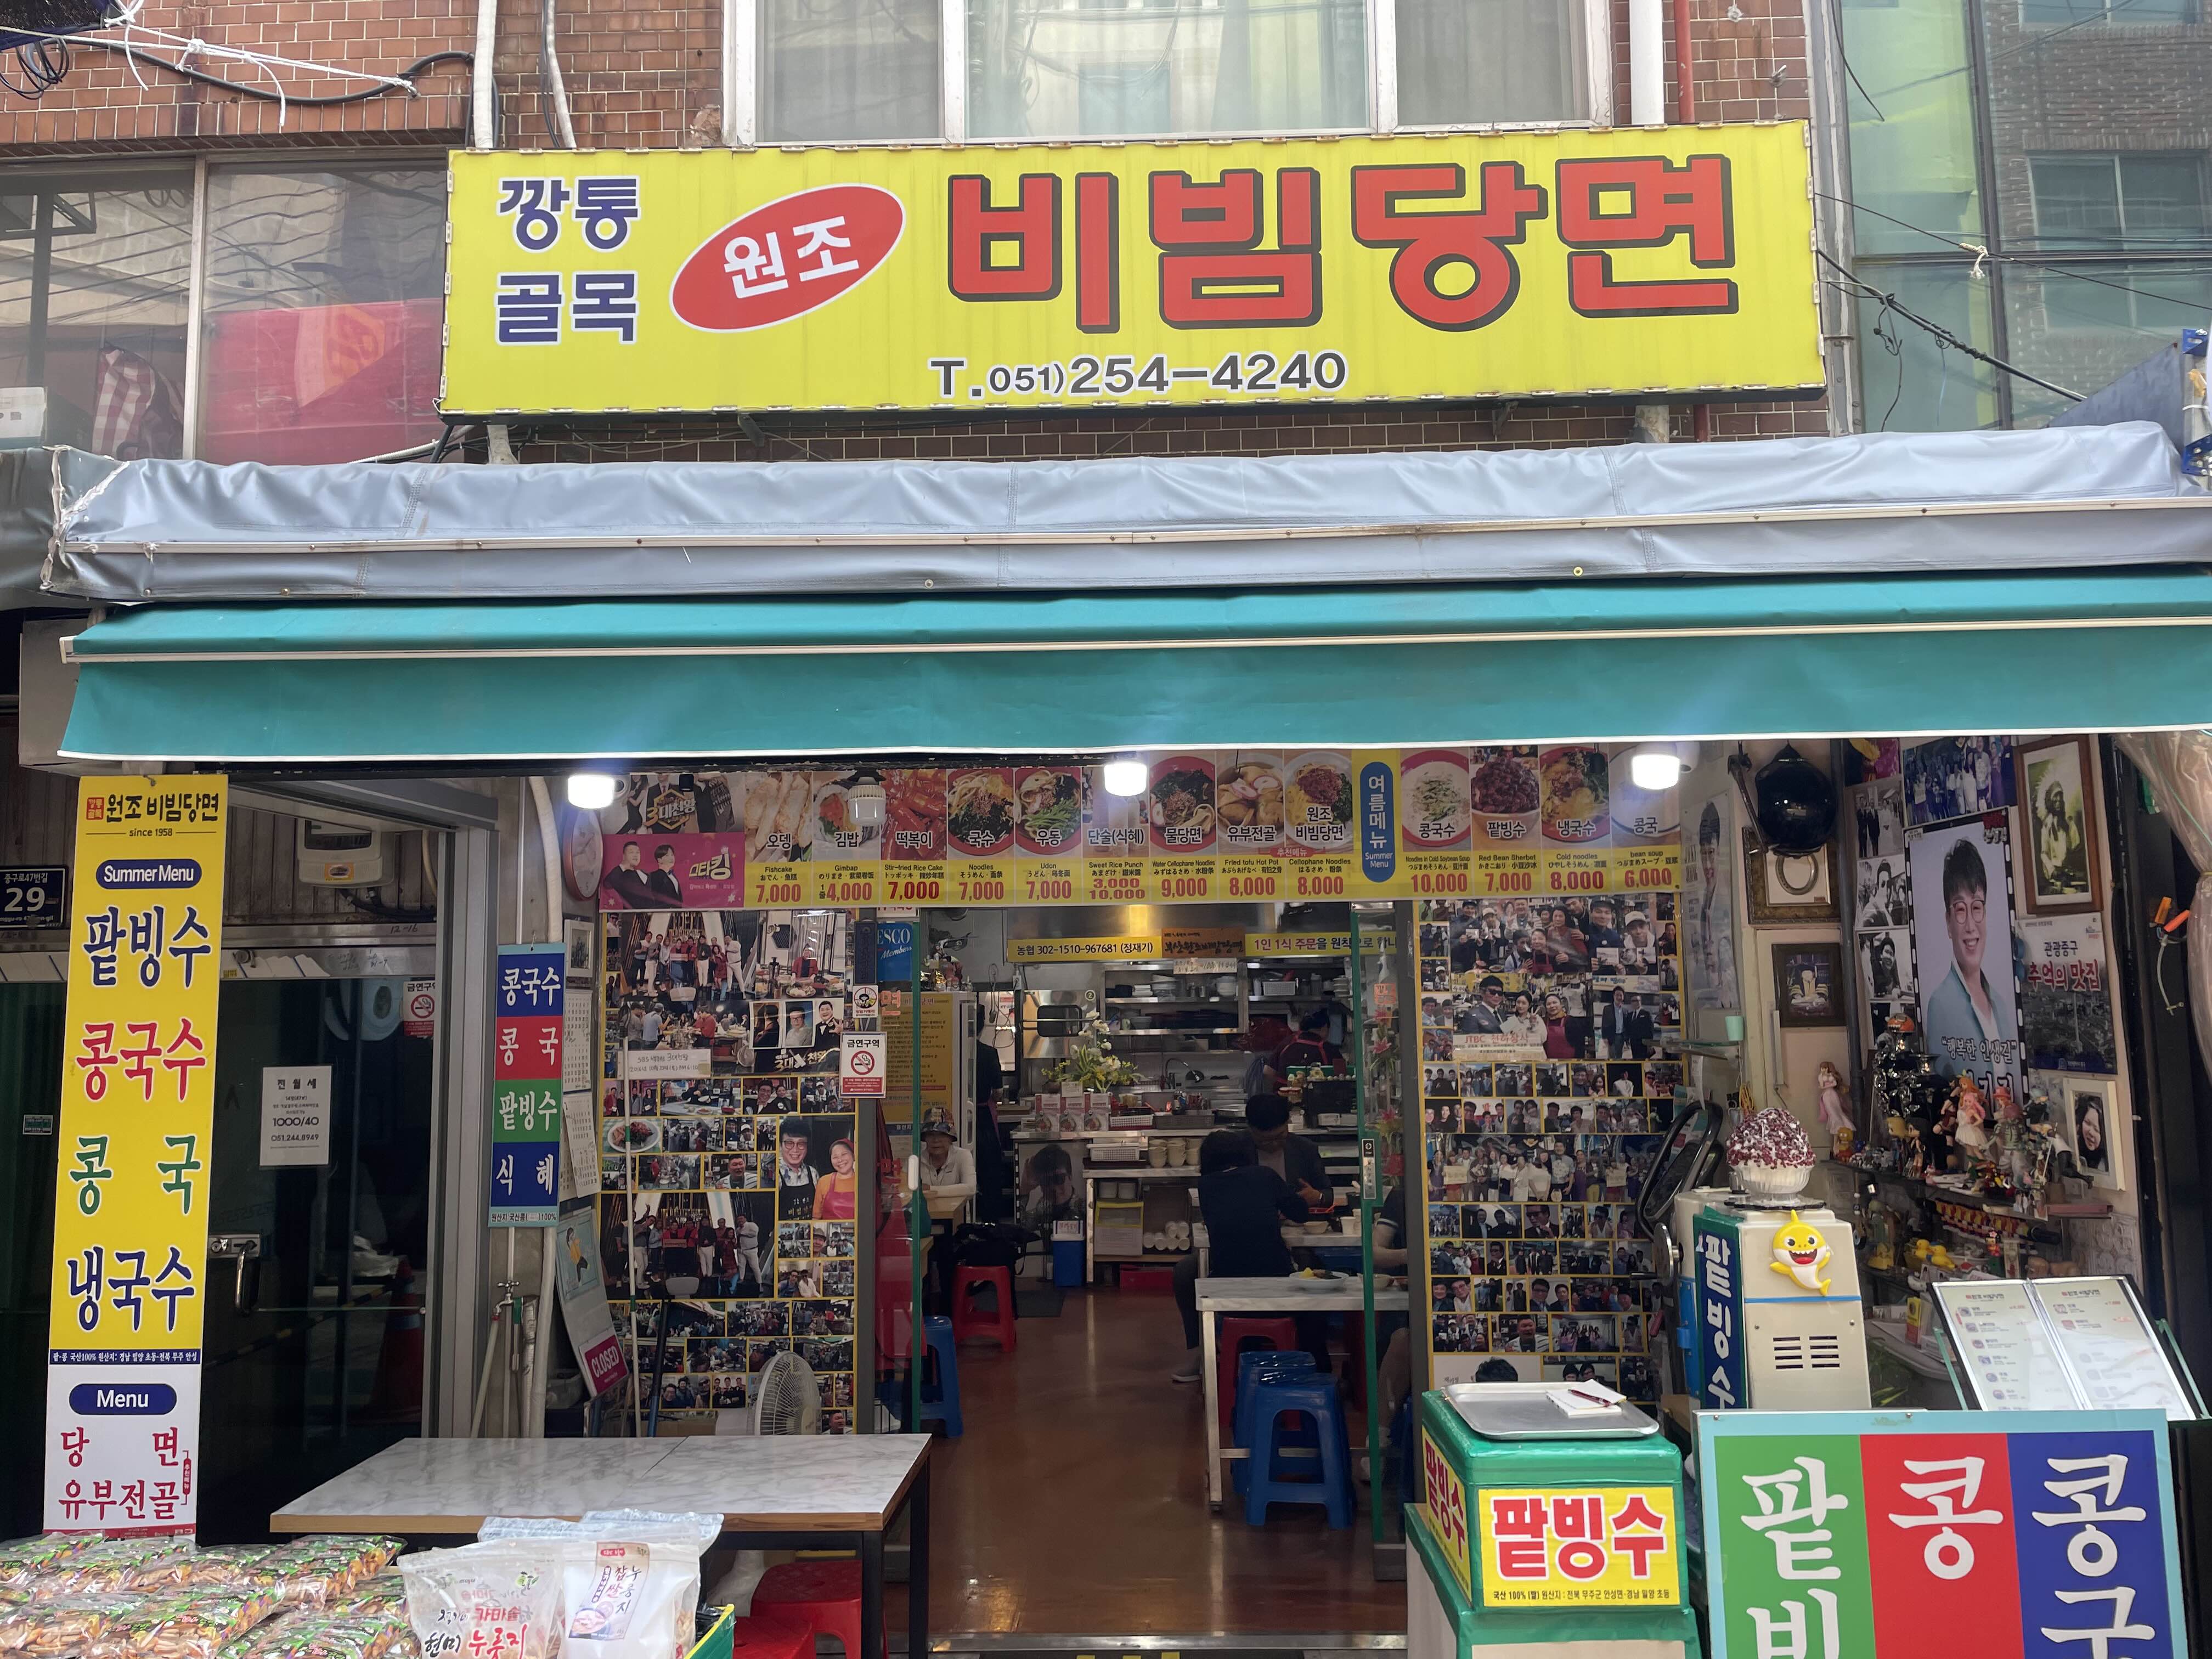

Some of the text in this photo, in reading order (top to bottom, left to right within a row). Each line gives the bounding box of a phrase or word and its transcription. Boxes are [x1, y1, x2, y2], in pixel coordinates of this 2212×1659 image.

[498, 176, 640, 252] 깡통
[947, 154, 1739, 334] 비빔당면
[724, 216, 860, 299] 원조
[495, 271, 639, 345] 골목
[106, 793, 219, 823] 원조 비빔당면
[1307, 806, 1332, 821] 원조
[1227, 826, 1276, 842] 유부전골
[1296, 825, 1344, 842] 비빔당면
[1419, 823, 1456, 839] 콩국수
[1488, 822, 1526, 838] 팥빙수
[1557, 820, 1595, 836] 냉국수
[1634, 817, 1658, 833] 콩국
[768, 833, 791, 849] 오뎅
[835, 832, 859, 847] 김밥
[969, 830, 994, 847] 국수
[1036, 830, 1062, 846] 우동
[1088, 829, 1144, 845] 단술(식혜)
[1165, 827, 1201, 844] 물당면
[1277, 848, 1307, 857] 추천메뉴
[1365, 852, 1393, 860] Summer
[104, 865, 194, 882] Summer Menu
[1411, 873, 1468, 893] 10,000
[1485, 872, 1532, 892] 7,000
[1550, 871, 1604, 891] 8,000
[1625, 868, 1672, 888] 6,000
[827, 883, 872, 902] 4,000
[888, 882, 939, 900] 7,000
[959, 881, 1004, 901] 7,000
[1026, 881, 1071, 901] 7,000
[1093, 878, 1139, 889] 3,000
[1161, 878, 1207, 898] 9,000
[1229, 877, 1276, 896] 8,000
[1297, 876, 1344, 896] 8,000
[4, 887, 45, 911] 29
[755, 884, 801, 903] 7,000
[1089, 889, 1146, 900] 10,000
[83, 906, 211, 988] 팥빙수
[881, 945, 912, 959] Members
[1017, 942, 1153, 956] 농협 302-1510-967681 (정재기)
[1255, 938, 1327, 950] 1인 1식 주문을
[2028, 959, 2101, 990] 추억의 맛집
[501, 967, 561, 1006] 콩국수
[847, 1039, 879, 1047] 금연구역
[76, 1018, 206, 1102] 콩국수
[499, 1091, 557, 1131] 팥빙수
[273, 1116, 319, 1126] 1000/40
[70, 1134, 201, 1216] 콩 국
[67, 1246, 195, 1331] 냉국수
[1706, 1234, 1735, 1409] 팥빙수
[591, 1346, 619, 1378] CLOSED
[97, 1389, 149, 1408] Menu
[61, 1426, 178, 1467] 당 면
[58, 1480, 179, 1521] 유부전골
[1425, 1438, 1465, 1560] 팥빙수
[1888, 1456, 2003, 1580] 콩
[1491, 1495, 1667, 1581] 팥빙수
[1493, 1591, 1506, 1600] 국산
[1509, 1590, 1526, 1600] 100%
[425, 1632, 461, 1658] 현미
